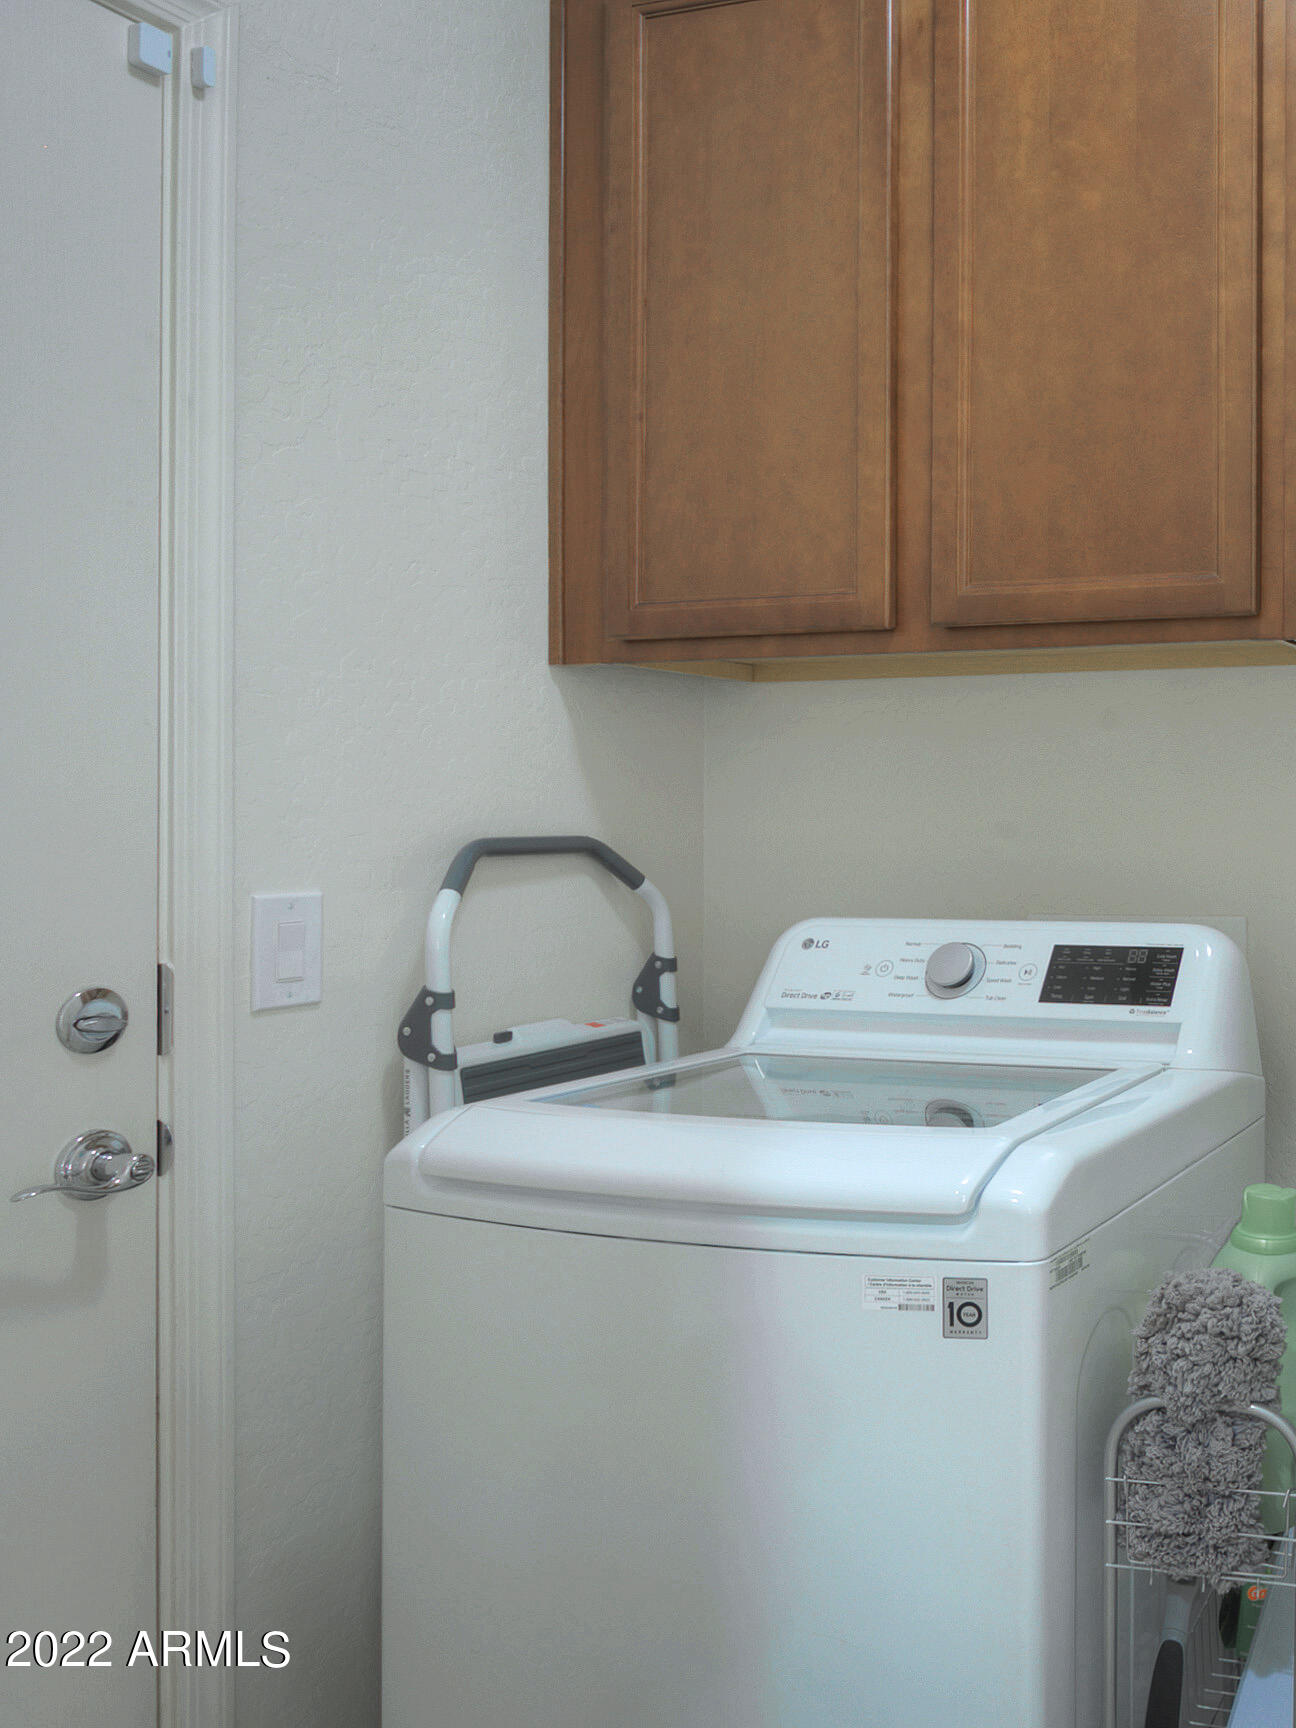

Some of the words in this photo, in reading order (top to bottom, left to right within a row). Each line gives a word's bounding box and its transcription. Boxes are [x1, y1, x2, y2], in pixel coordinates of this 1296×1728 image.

[815, 939, 830, 949] LG
[801, 992, 819, 1000] Drive
[947, 1301, 983, 1328] 10
